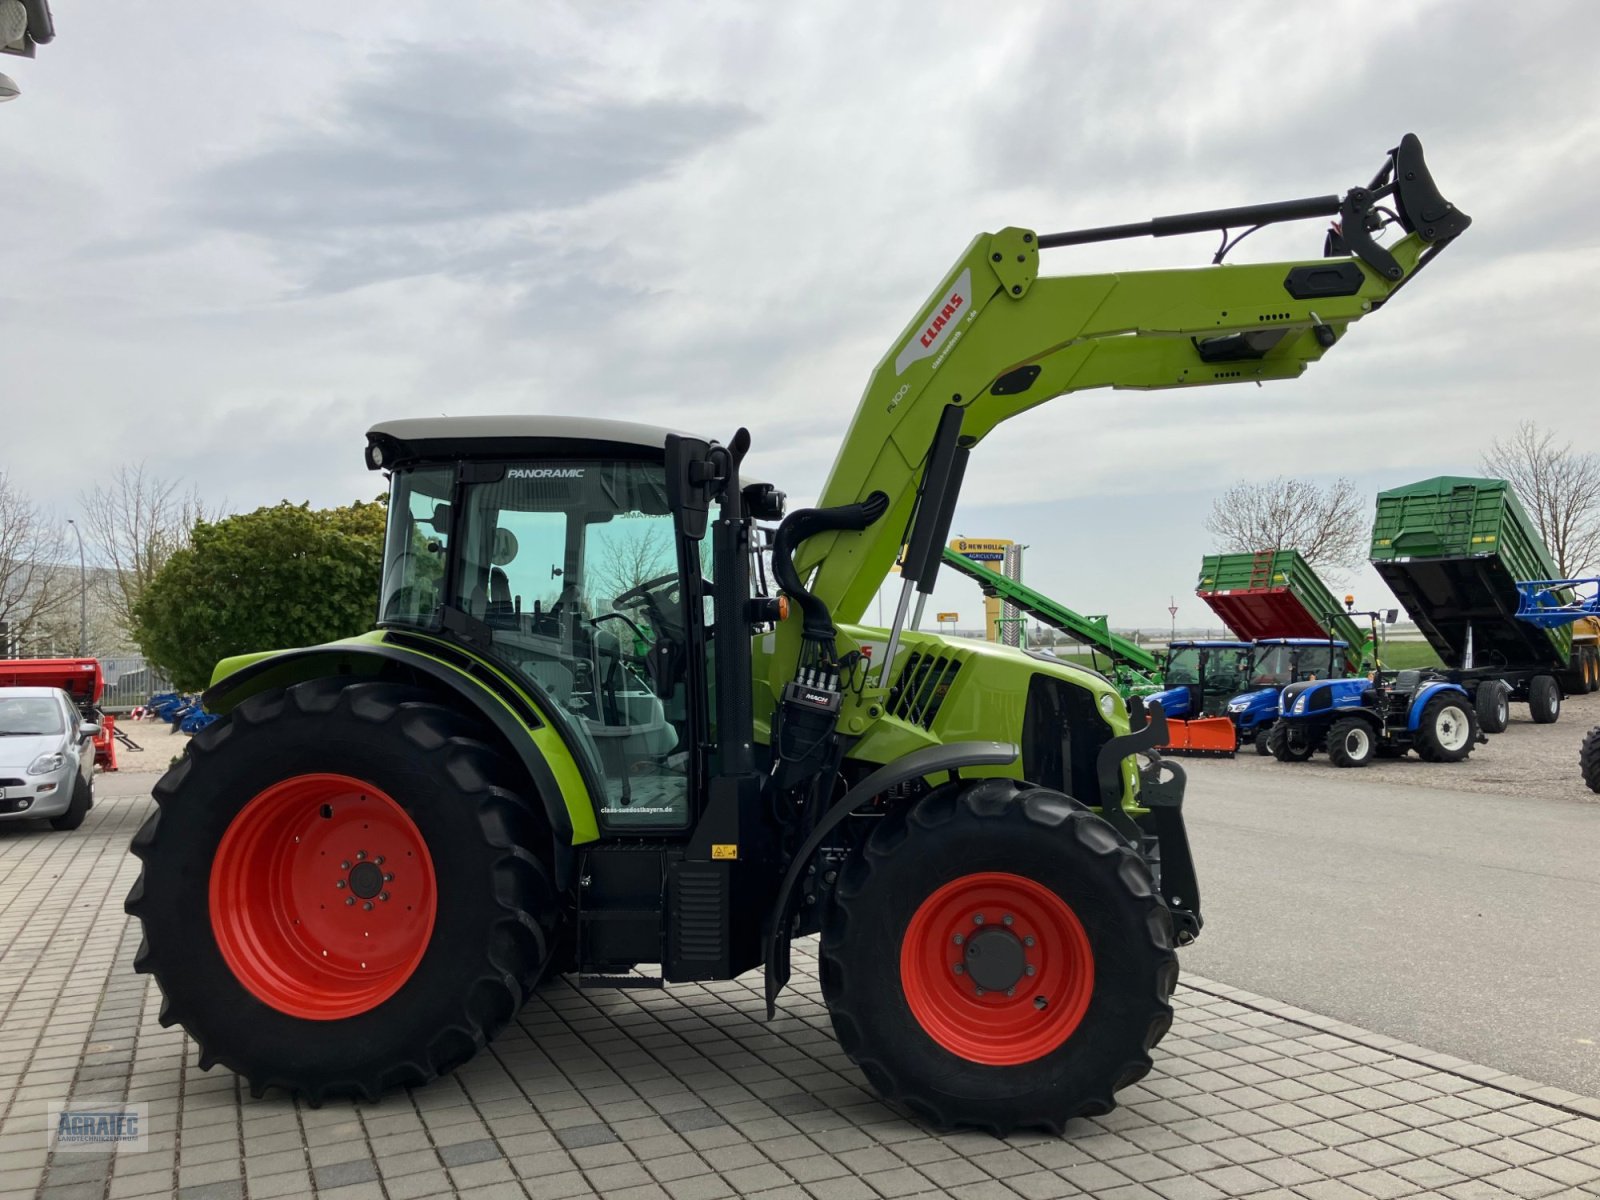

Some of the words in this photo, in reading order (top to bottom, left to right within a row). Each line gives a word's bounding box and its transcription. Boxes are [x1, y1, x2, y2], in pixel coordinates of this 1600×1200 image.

[920, 293, 964, 348] CLAAS
[507, 469, 585, 479] PANORAMIC
[805, 693, 829, 702] MACH
[600, 806, 673, 814] claas-suedostbayern.de
